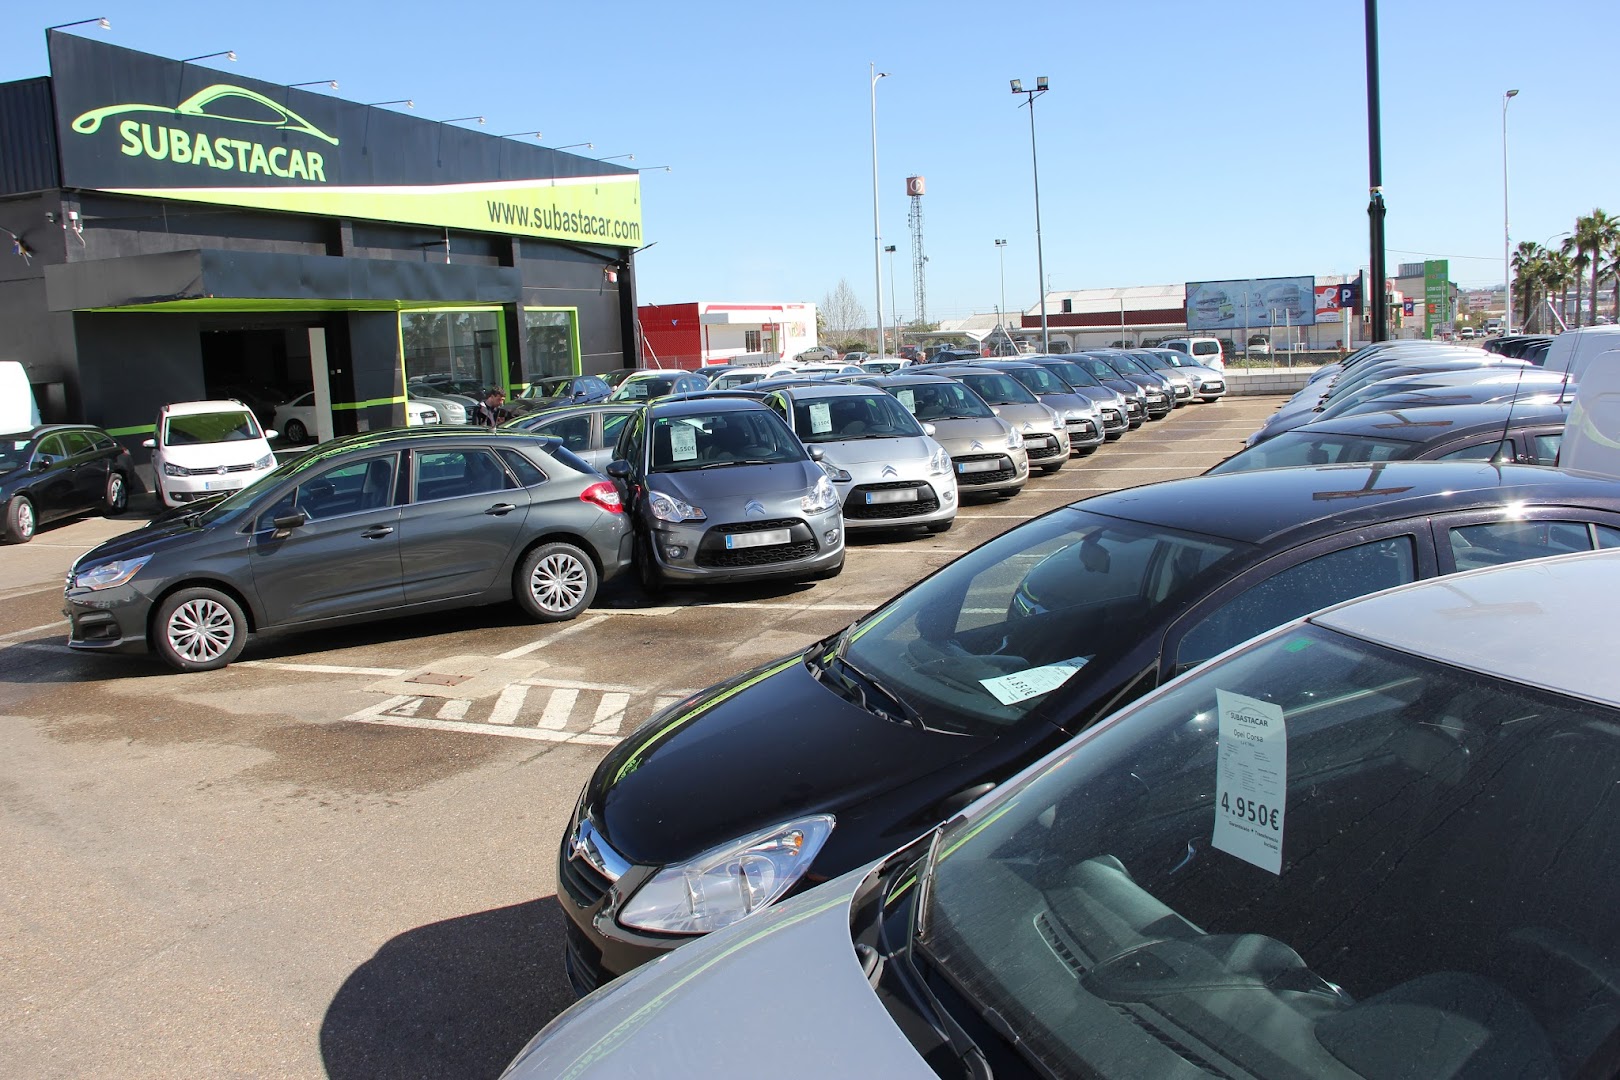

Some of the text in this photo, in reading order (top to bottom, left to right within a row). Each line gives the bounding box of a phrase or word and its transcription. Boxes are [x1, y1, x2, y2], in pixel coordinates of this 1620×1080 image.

[120, 120, 326, 182] SUBASTACAR
[487, 200, 639, 242] www.subastacar.com
[1342, 289, 1351, 302] P
[1406, 303, 1412, 311] P
[1231, 712, 1268, 727] SUBASTACAR
[1234, 728, 1264, 743] Opel Corsa
[1221, 791, 1279, 831] 4.950€
